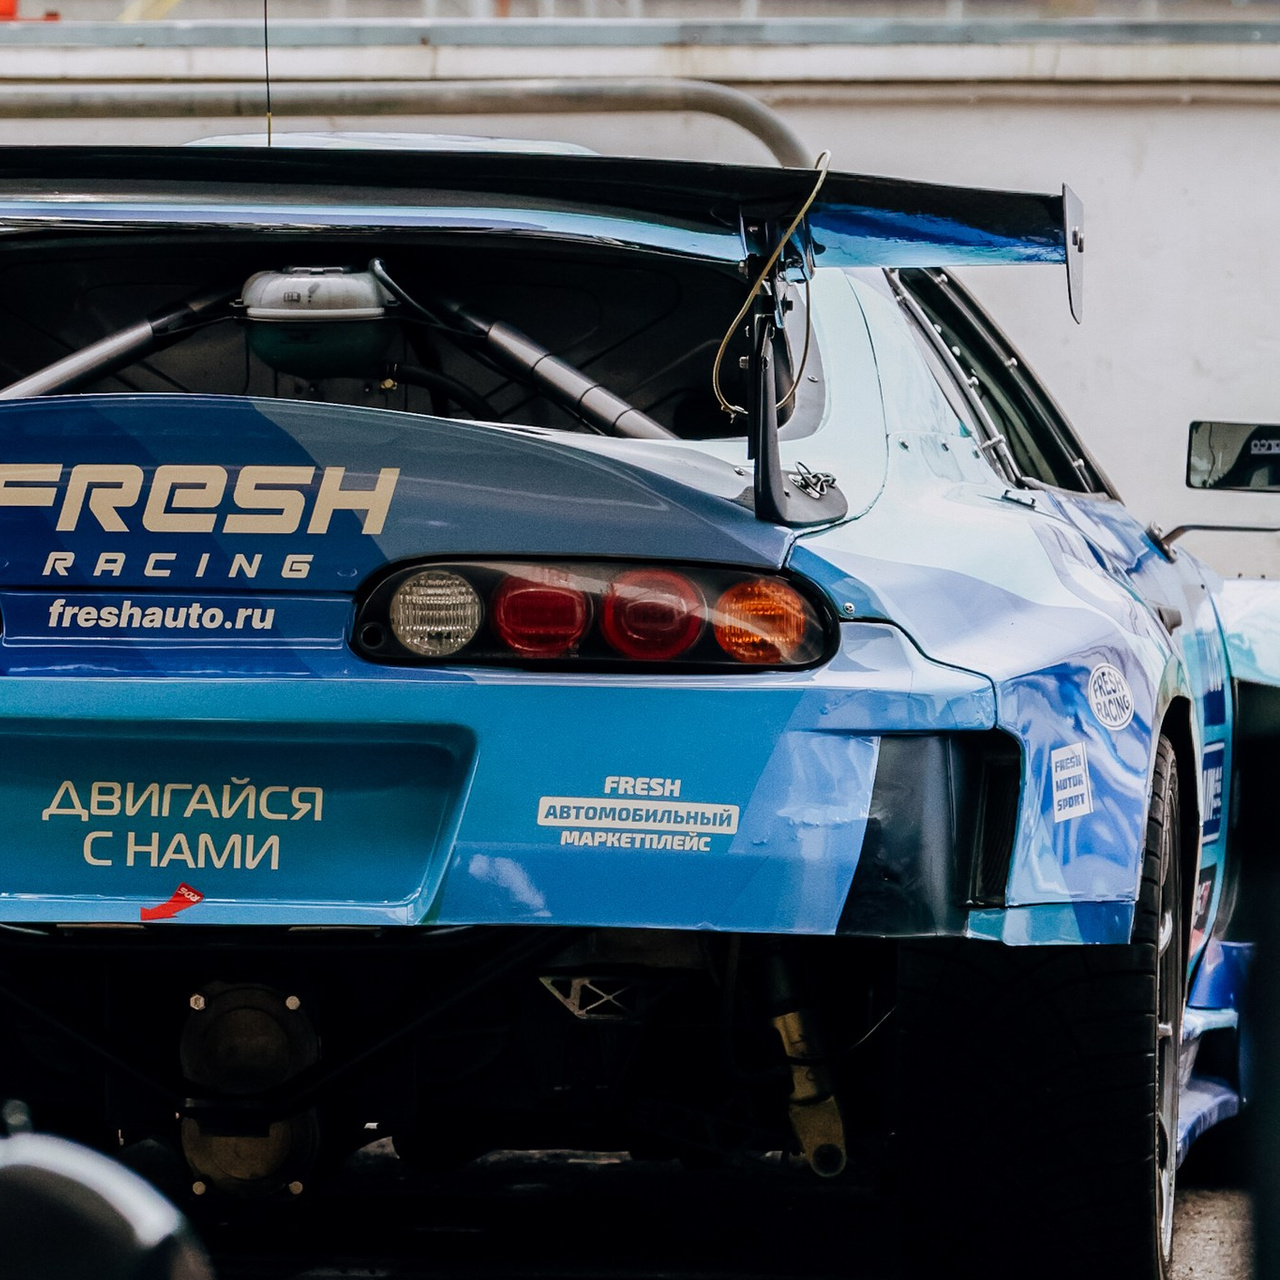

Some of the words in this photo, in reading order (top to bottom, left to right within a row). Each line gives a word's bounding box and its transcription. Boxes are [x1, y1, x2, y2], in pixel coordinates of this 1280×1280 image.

[42, 551, 314, 579] RACING
[48, 599, 275, 630] freshauto.ru
[1093, 671, 1124, 700] FRESH
[1096, 694, 1130, 721] RACING
[1054, 754, 1082, 773] FRESH
[604, 776, 682, 797] FRESH
[1055, 773, 1083, 792] MOTOR
[41, 777, 324, 821] ДВИГАЙСЯ
[1056, 792, 1085, 812] SPORT
[544, 804, 733, 827] АВТОМОБИЛЬНЫЙ
[83, 830, 114, 866] С
[126, 831, 280, 870] НАМИ
[560, 830, 712, 852] МАРКЕТПЛЕЙС
